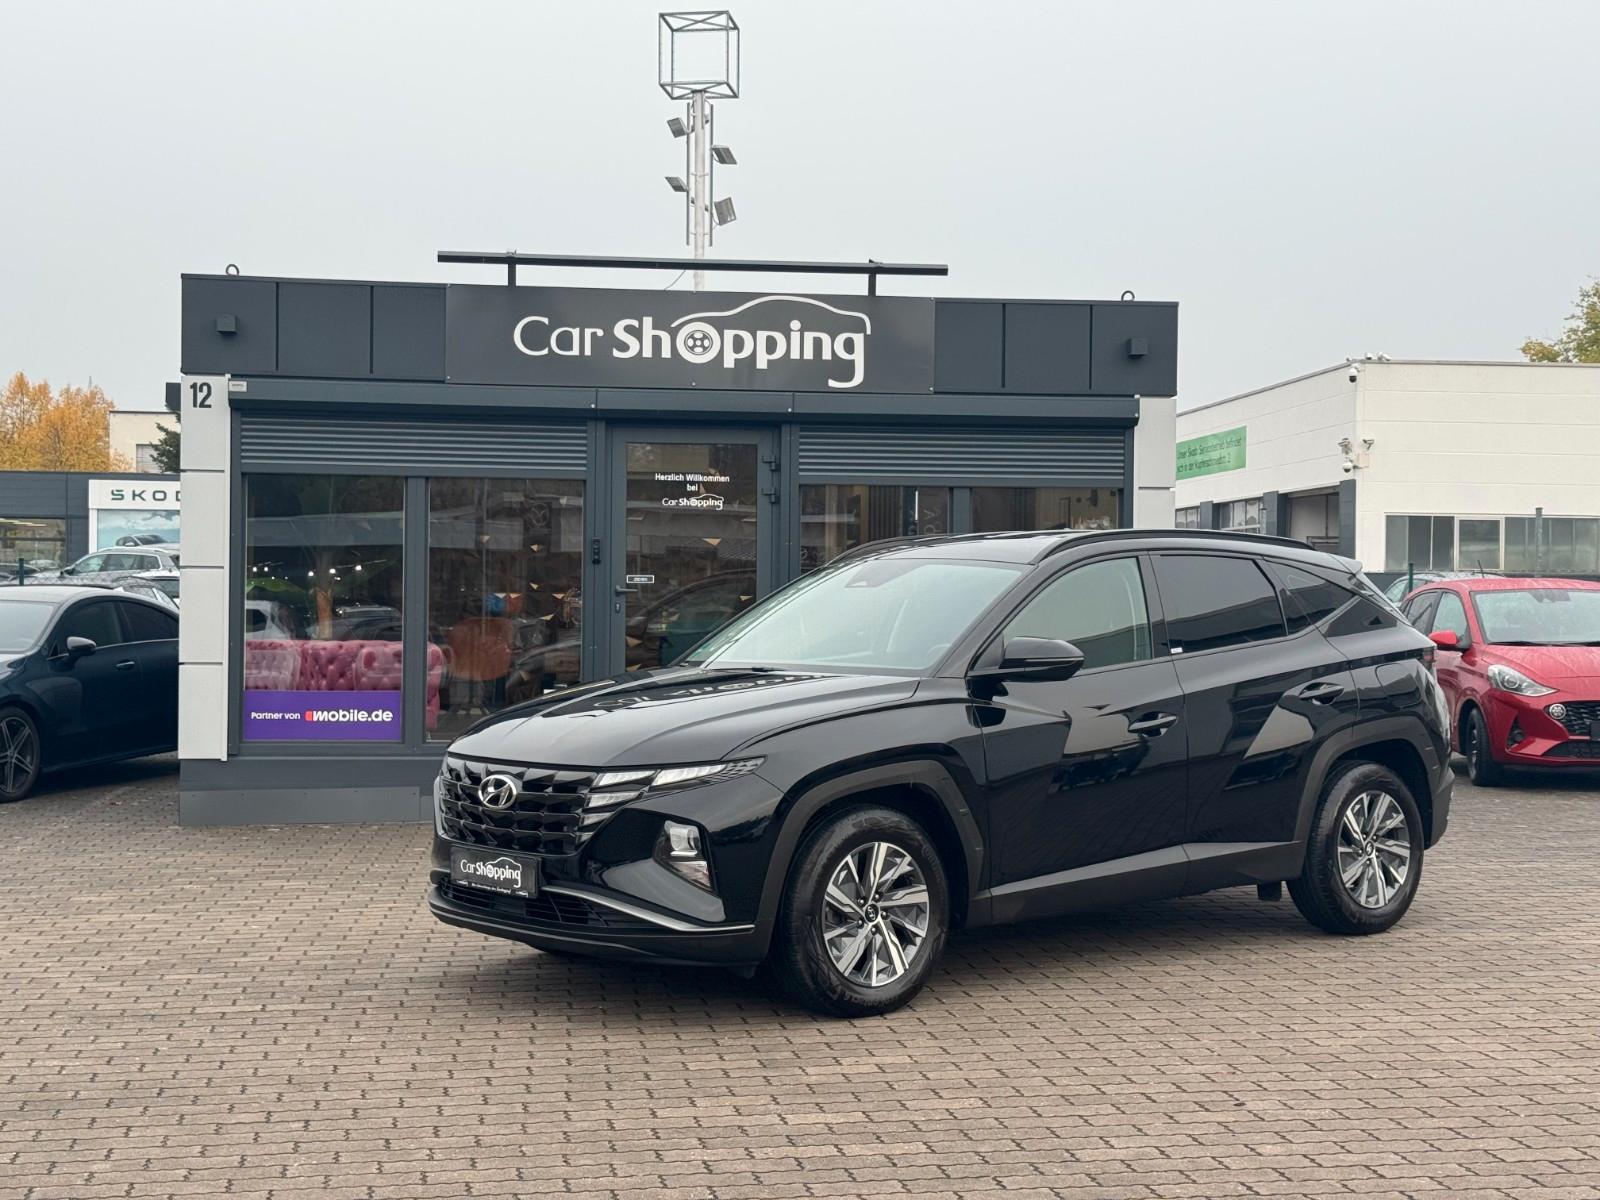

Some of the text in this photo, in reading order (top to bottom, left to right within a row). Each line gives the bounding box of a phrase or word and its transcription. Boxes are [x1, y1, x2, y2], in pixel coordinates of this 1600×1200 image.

[513, 315, 865, 388] Car Shopping
[189, 382, 212, 408] 12
[655, 473, 730, 482] Herzlich Willkommen
[686, 483, 698, 491] bei
[662, 497, 723, 511] Car Shopping
[250, 709, 393, 722] Partner von mobile.de
[460, 860, 521, 888] Car Shopping
